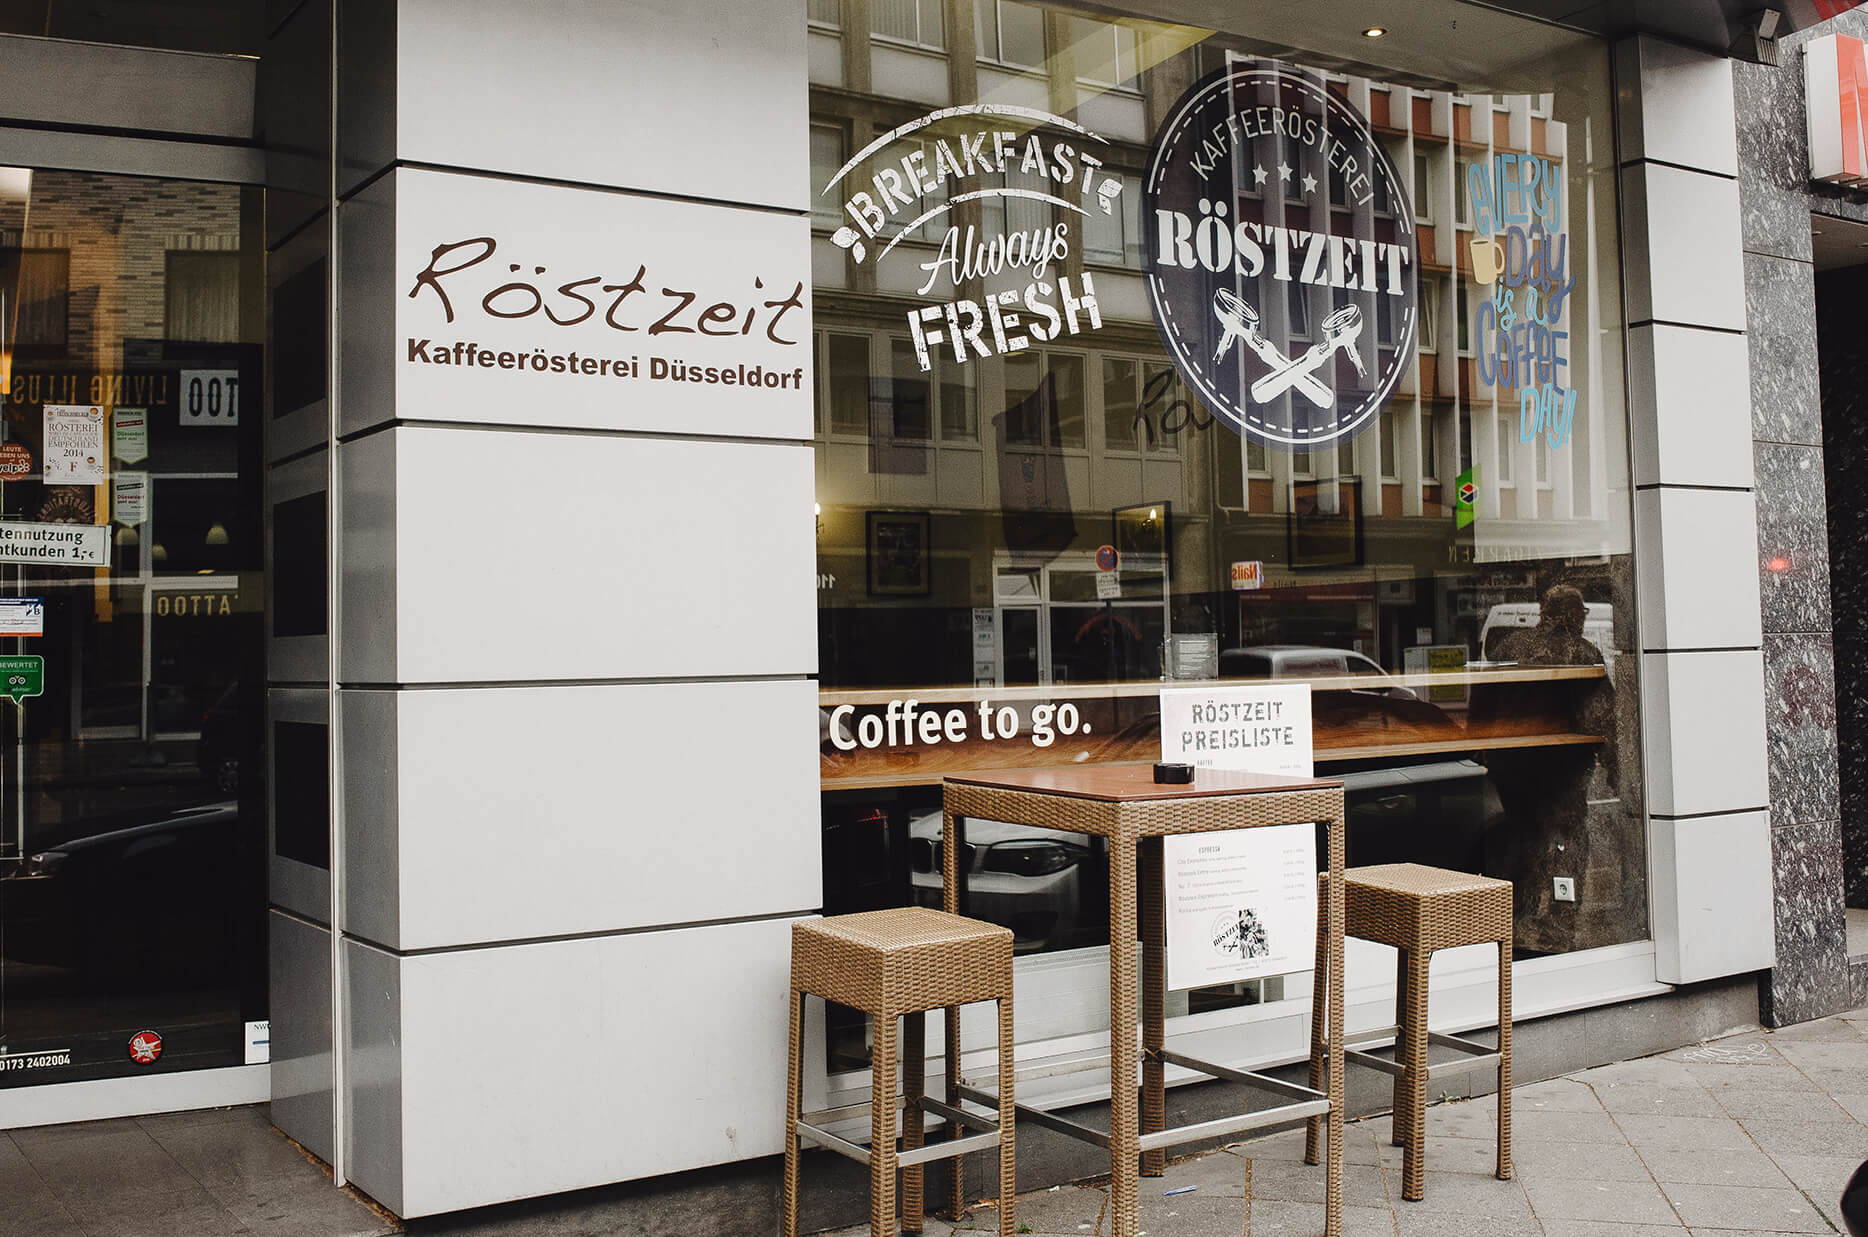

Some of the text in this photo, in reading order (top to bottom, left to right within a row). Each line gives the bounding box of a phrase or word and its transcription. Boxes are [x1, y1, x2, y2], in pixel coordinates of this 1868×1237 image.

[845, 131, 1103, 239] BREAKFAST
[1190, 105, 1375, 206] KAFFEERÖSTEREI
[917, 223, 1068, 295] Always
[1155, 198, 1409, 296] RÖSTZEIT
[408, 236, 803, 346] Röstzeit
[907, 272, 1103, 372] FRESH
[407, 337, 803, 390] Kaffeerösterei Düsseldorf
[63, 449, 83, 458] 2014
[829, 699, 1092, 750] Coffee to go.
[1182, 726, 1294, 751] PREISLISTE
[1192, 701, 1283, 724] RÖSTZEIT
[27, 1054, 70, 1068] 2402004
